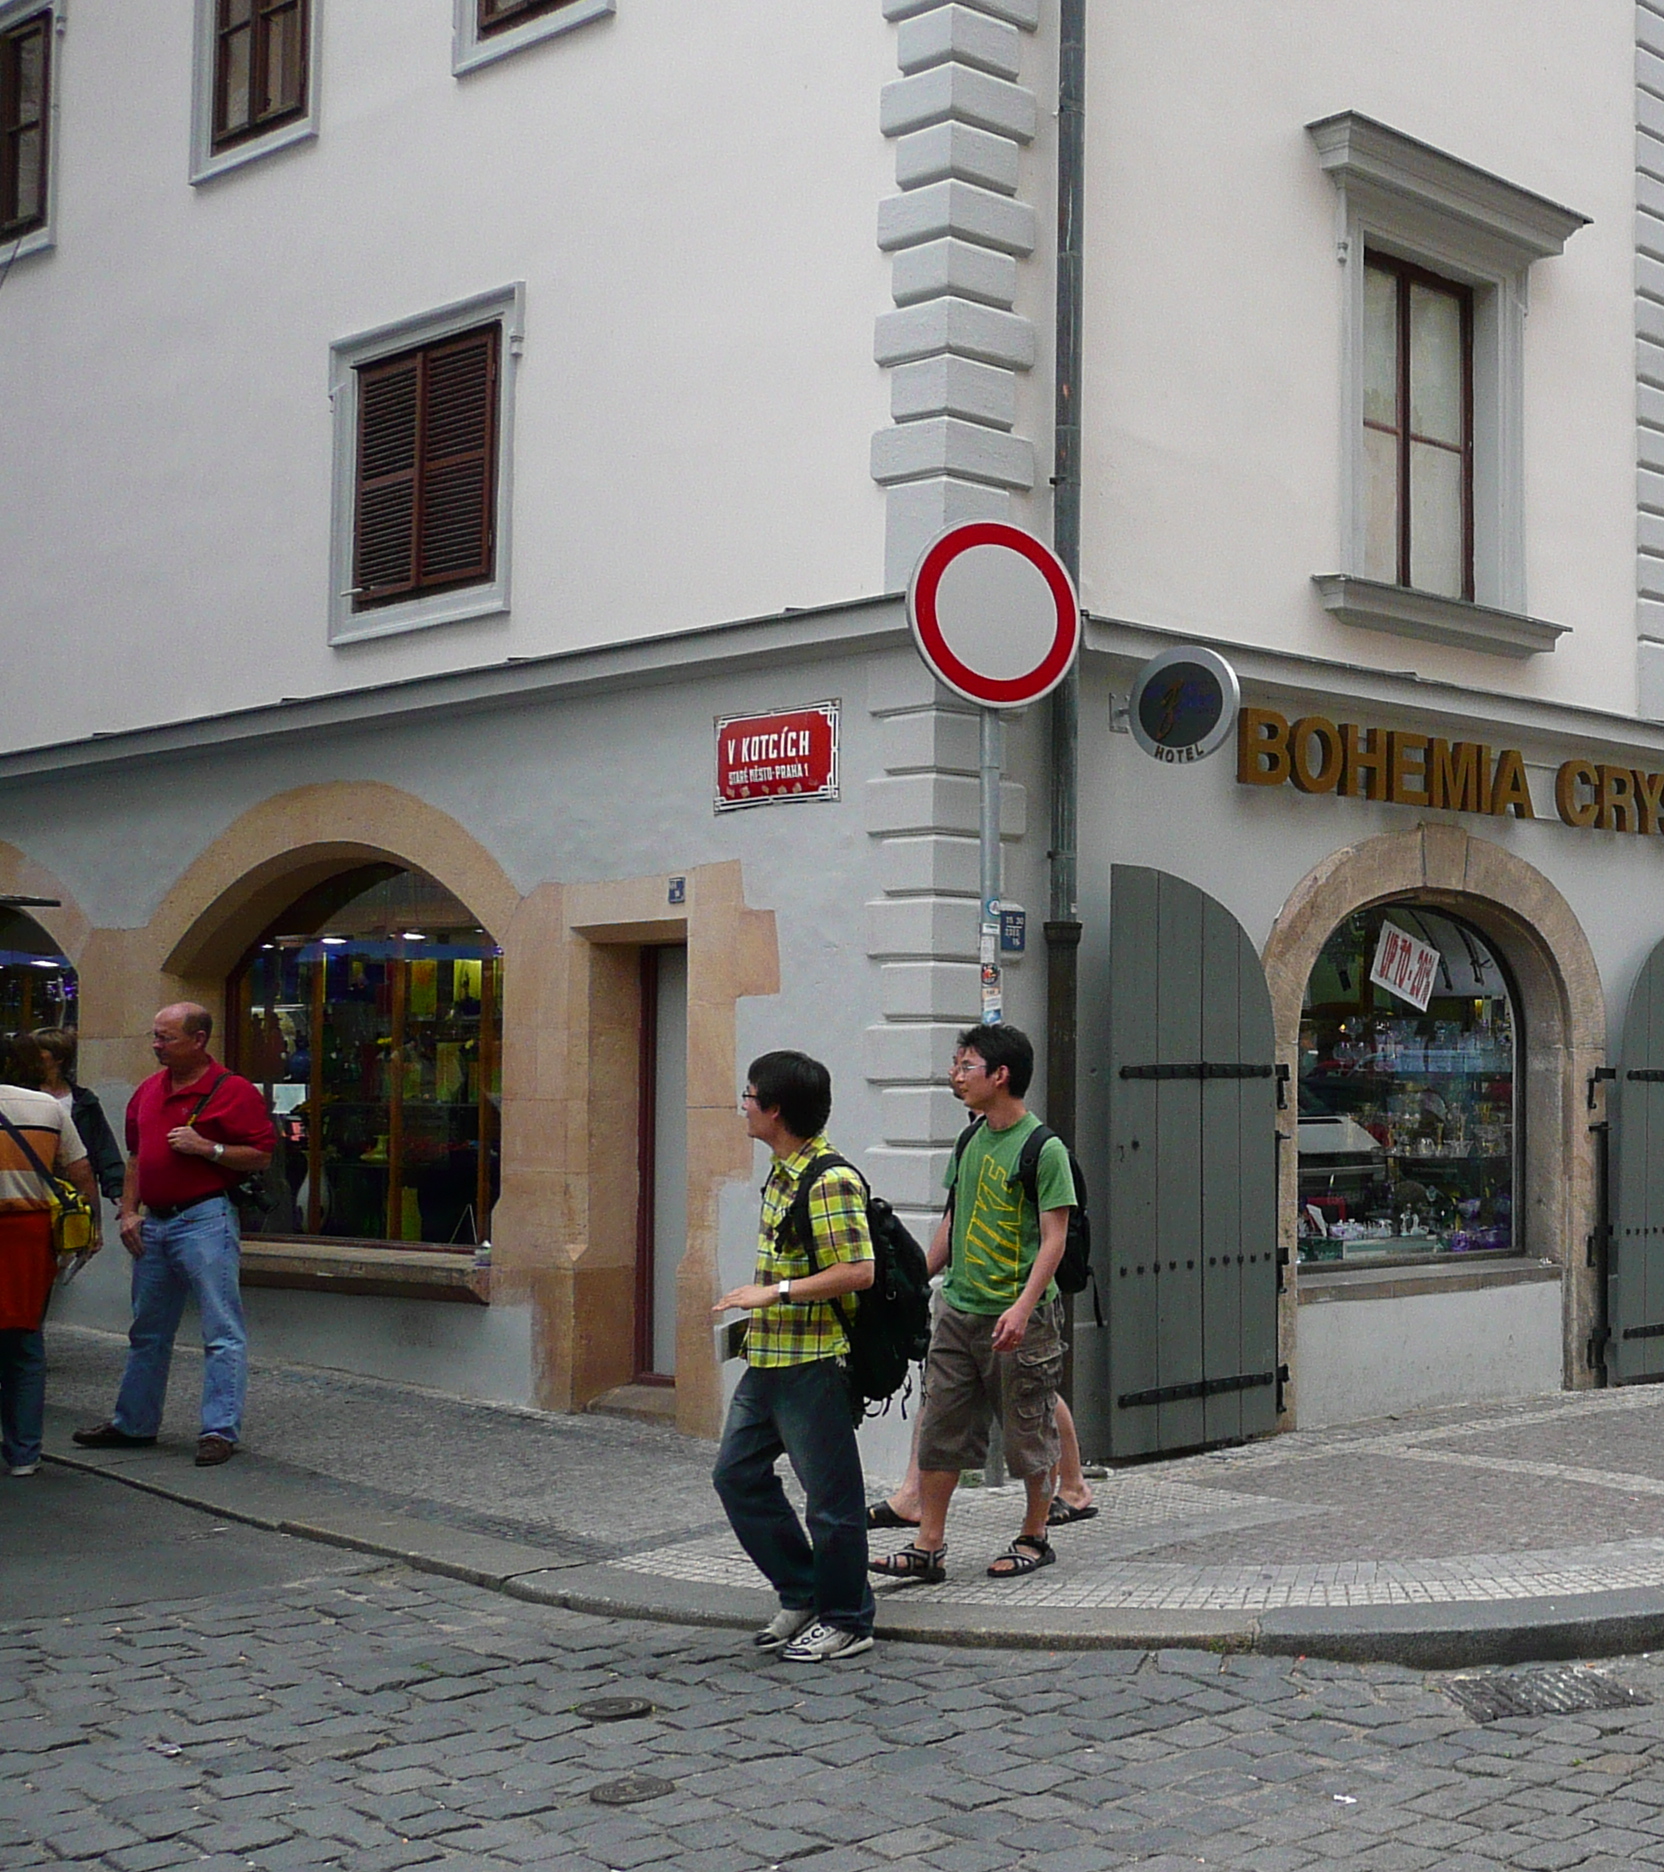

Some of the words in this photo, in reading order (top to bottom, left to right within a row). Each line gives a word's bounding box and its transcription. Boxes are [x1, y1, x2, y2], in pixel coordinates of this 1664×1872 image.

[728, 739, 736, 765] V
[742, 726, 809, 762] KOTCÍCH
[1154, 743, 1205, 763] HOTEL
[1237, 707, 1537, 820] BOHEMIA
[728, 766, 748, 786] STARÉ
[1379, 930, 1400, 980] UP
[1394, 938, 1413, 989] TO
[964, 1154, 1025, 1298] NIKE
